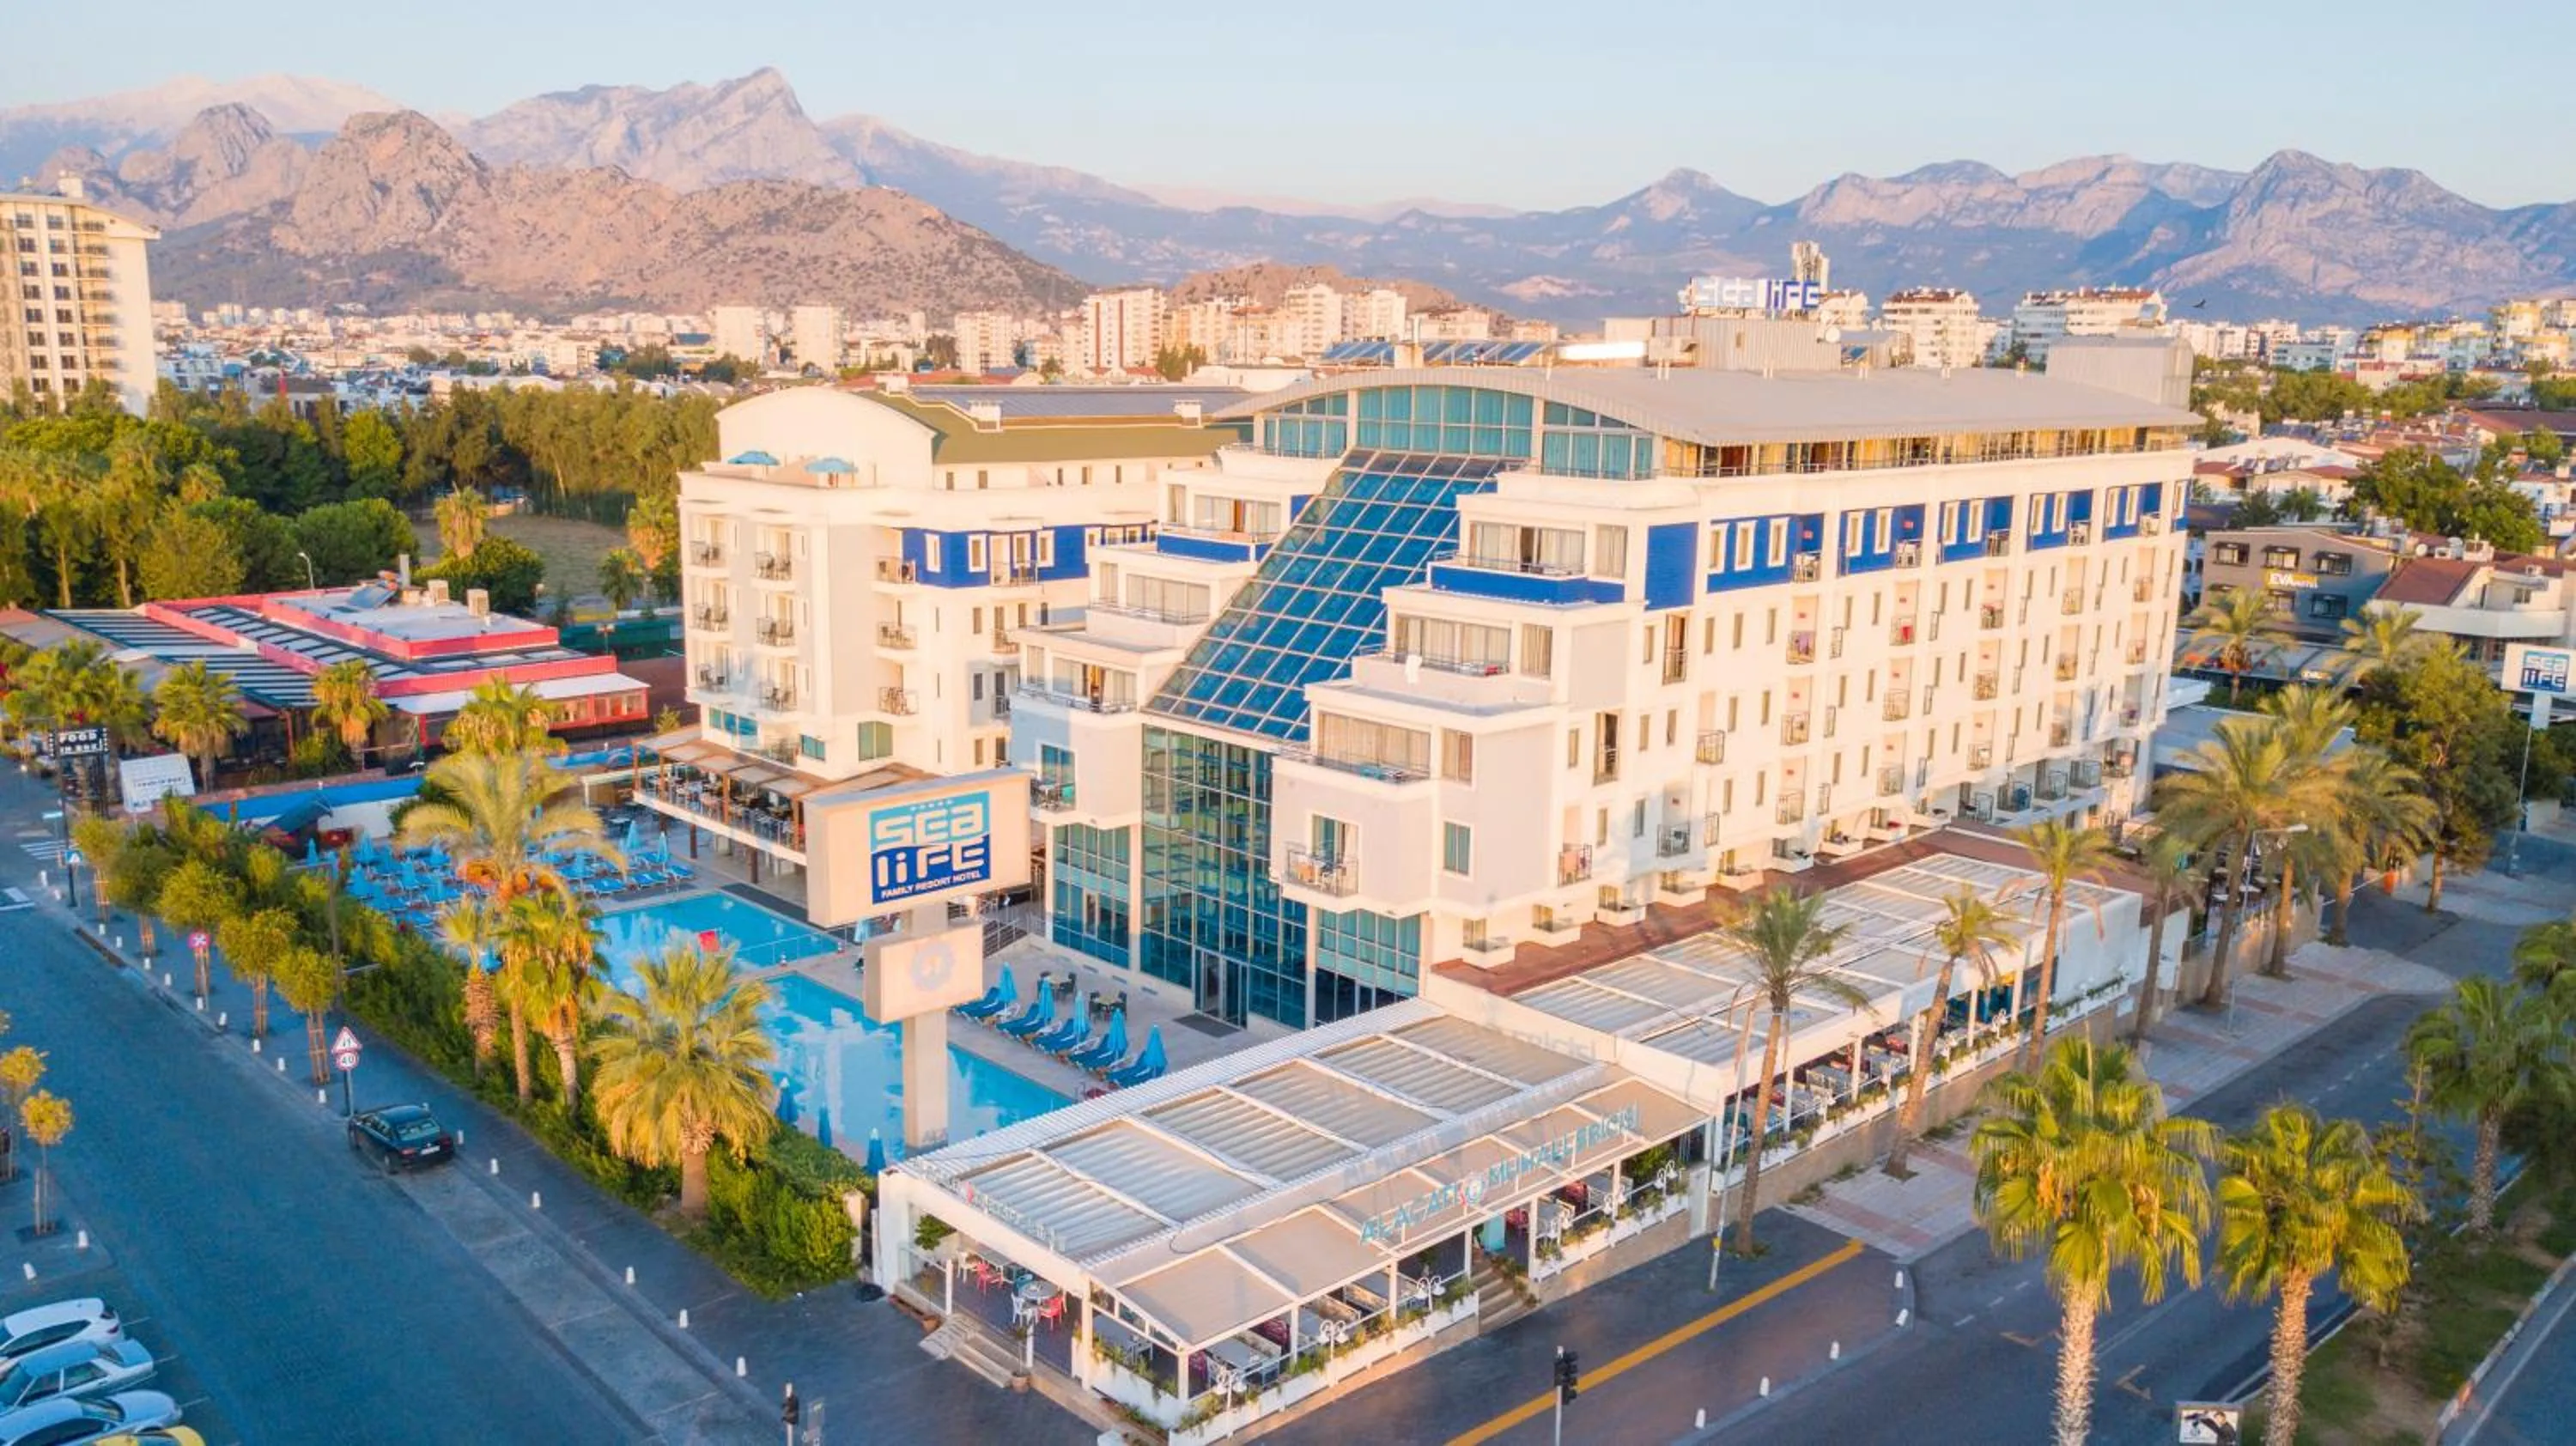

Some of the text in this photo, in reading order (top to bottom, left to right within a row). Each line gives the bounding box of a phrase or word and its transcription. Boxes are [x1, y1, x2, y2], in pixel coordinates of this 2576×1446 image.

[881, 870, 981, 900] FAMILY RESORT HOTEL
